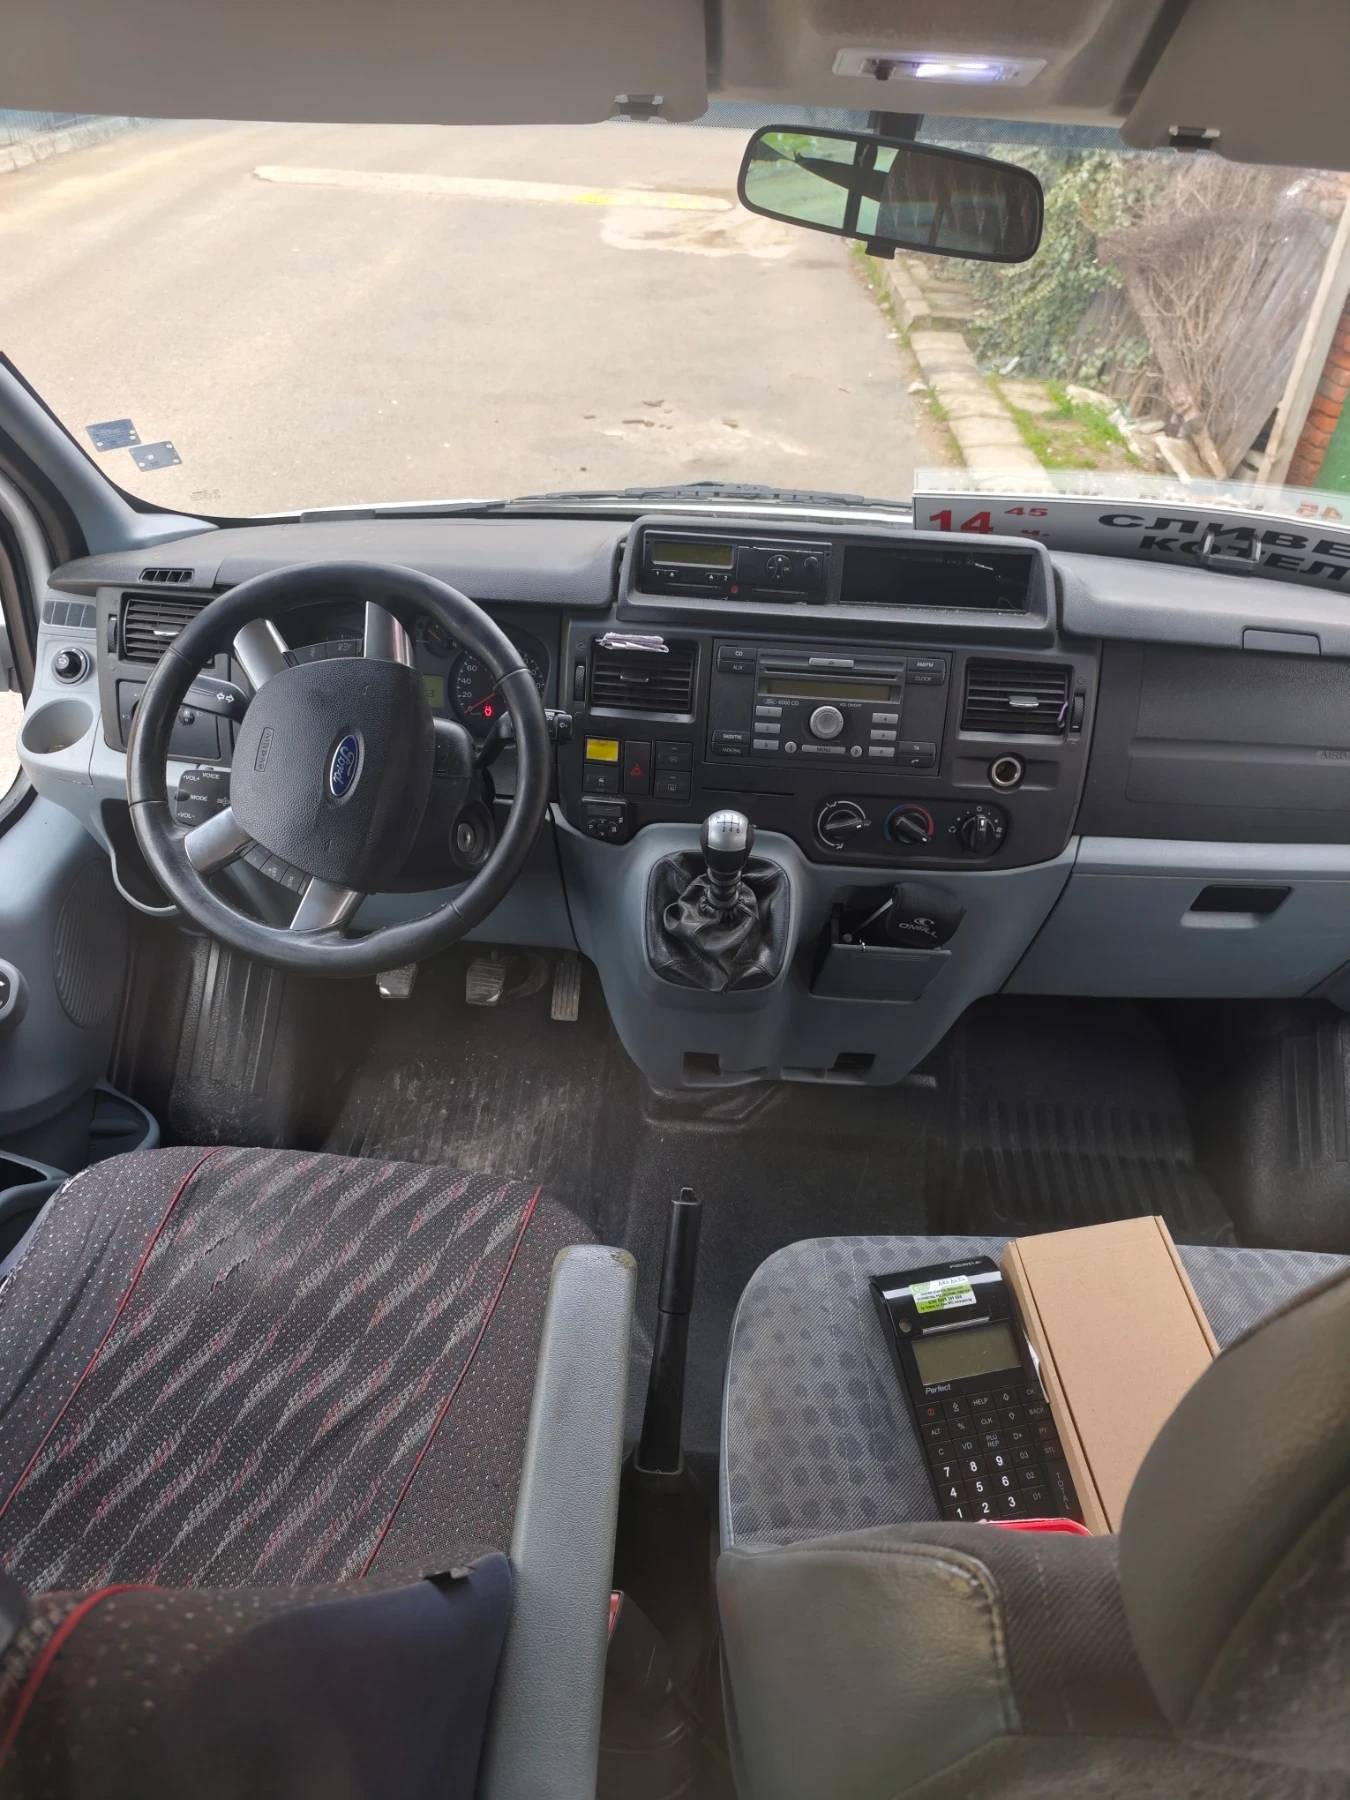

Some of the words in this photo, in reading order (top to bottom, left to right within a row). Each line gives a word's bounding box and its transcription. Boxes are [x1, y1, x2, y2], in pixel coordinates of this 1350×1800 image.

[929, 510, 995, 534] 14
[1004, 507, 1049, 517] 45
[1098, 514, 1350, 559] СЛИВЕ
[466, 664, 478, 672] 60
[460, 677, 472, 685] 40
[333, 746, 355, 785] Ford
[202, 772, 220, 780] VOICE
[190, 794, 208, 802] MODE
[925, 1384, 951, 1395] Perfect
[972, 1398, 988, 1406] HELP
[1028, 1407, 1046, 1416] BACK
[980, 1417, 993, 1425] CLK
[931, 1428, 941, 1436] ALT
[1013, 1432, 1023, 1440] D+
[986, 1433, 998, 1441] PLU
[961, 1442, 973, 1450] VD
[987, 1440, 1000, 1448] REP
[938, 1448, 945, 1456] C
[1044, 1446, 1056, 1454] STL
[1020, 1451, 1029, 1459] 03
[995, 1455, 1004, 1467] 9
[969, 1461, 978, 1472] 8
[943, 1466, 950, 1477] 7
[1025, 1471, 1036, 1480] 02
[1001, 1475, 1010, 1487] 6
[975, 1481, 984, 1492] 5
[1055, 1471, 1071, 1510] TOTAL
[950, 1486, 958, 1497] 4
[1032, 1492, 1042, 1501] 01
[1007, 1496, 1016, 1507] 3
[981, 1502, 990, 1513] 2
[956, 1507, 963, 1519] 1
